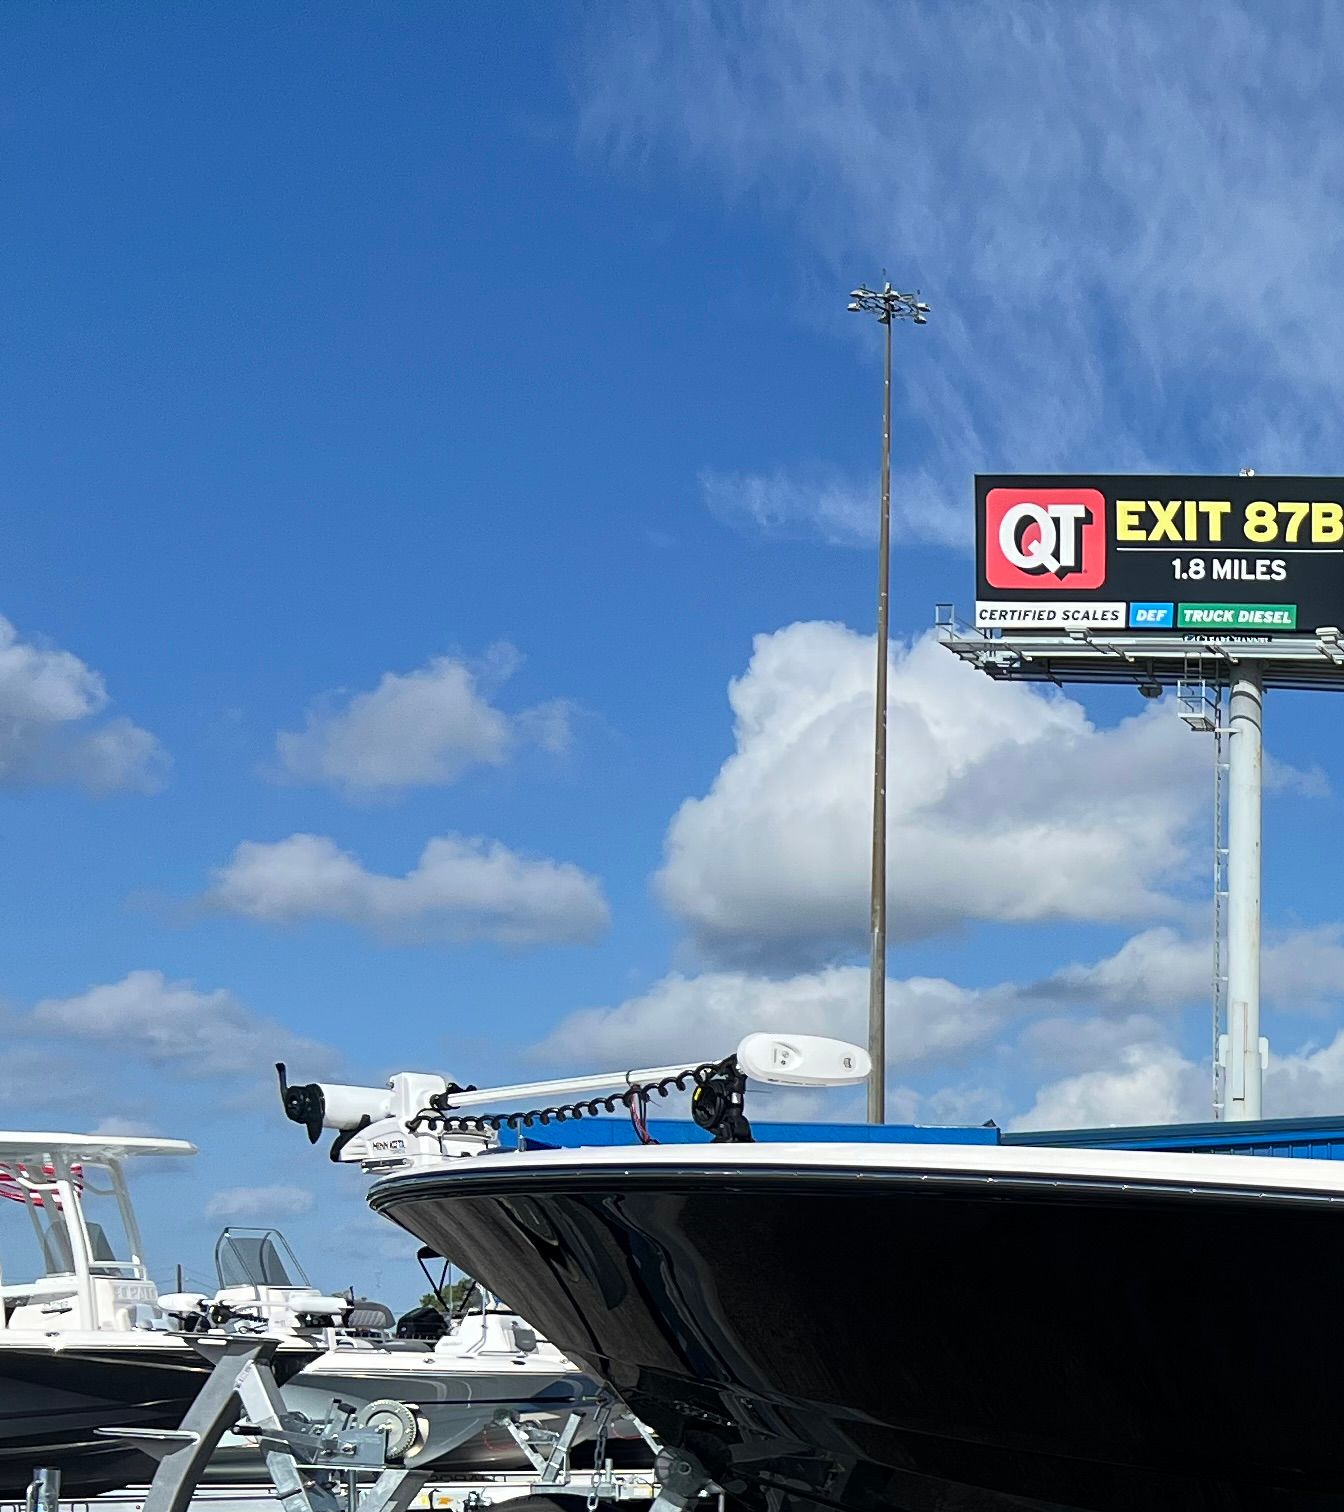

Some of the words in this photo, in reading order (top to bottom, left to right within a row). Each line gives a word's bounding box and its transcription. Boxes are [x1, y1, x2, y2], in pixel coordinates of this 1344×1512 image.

[1115, 499, 1231, 542] EXIT
[1243, 501, 1344, 543] 87B
[998, 502, 1088, 576] QT
[1171, 558, 1206, 580] 1.8
[1212, 559, 1287, 581] MILES
[978, 608, 1057, 622] CERTIFIED
[1061, 609, 1121, 623] SCALES
[1135, 609, 1168, 622] DEF
[1182, 609, 1236, 624] TRUCK
[1237, 610, 1293, 625] DIESEL
